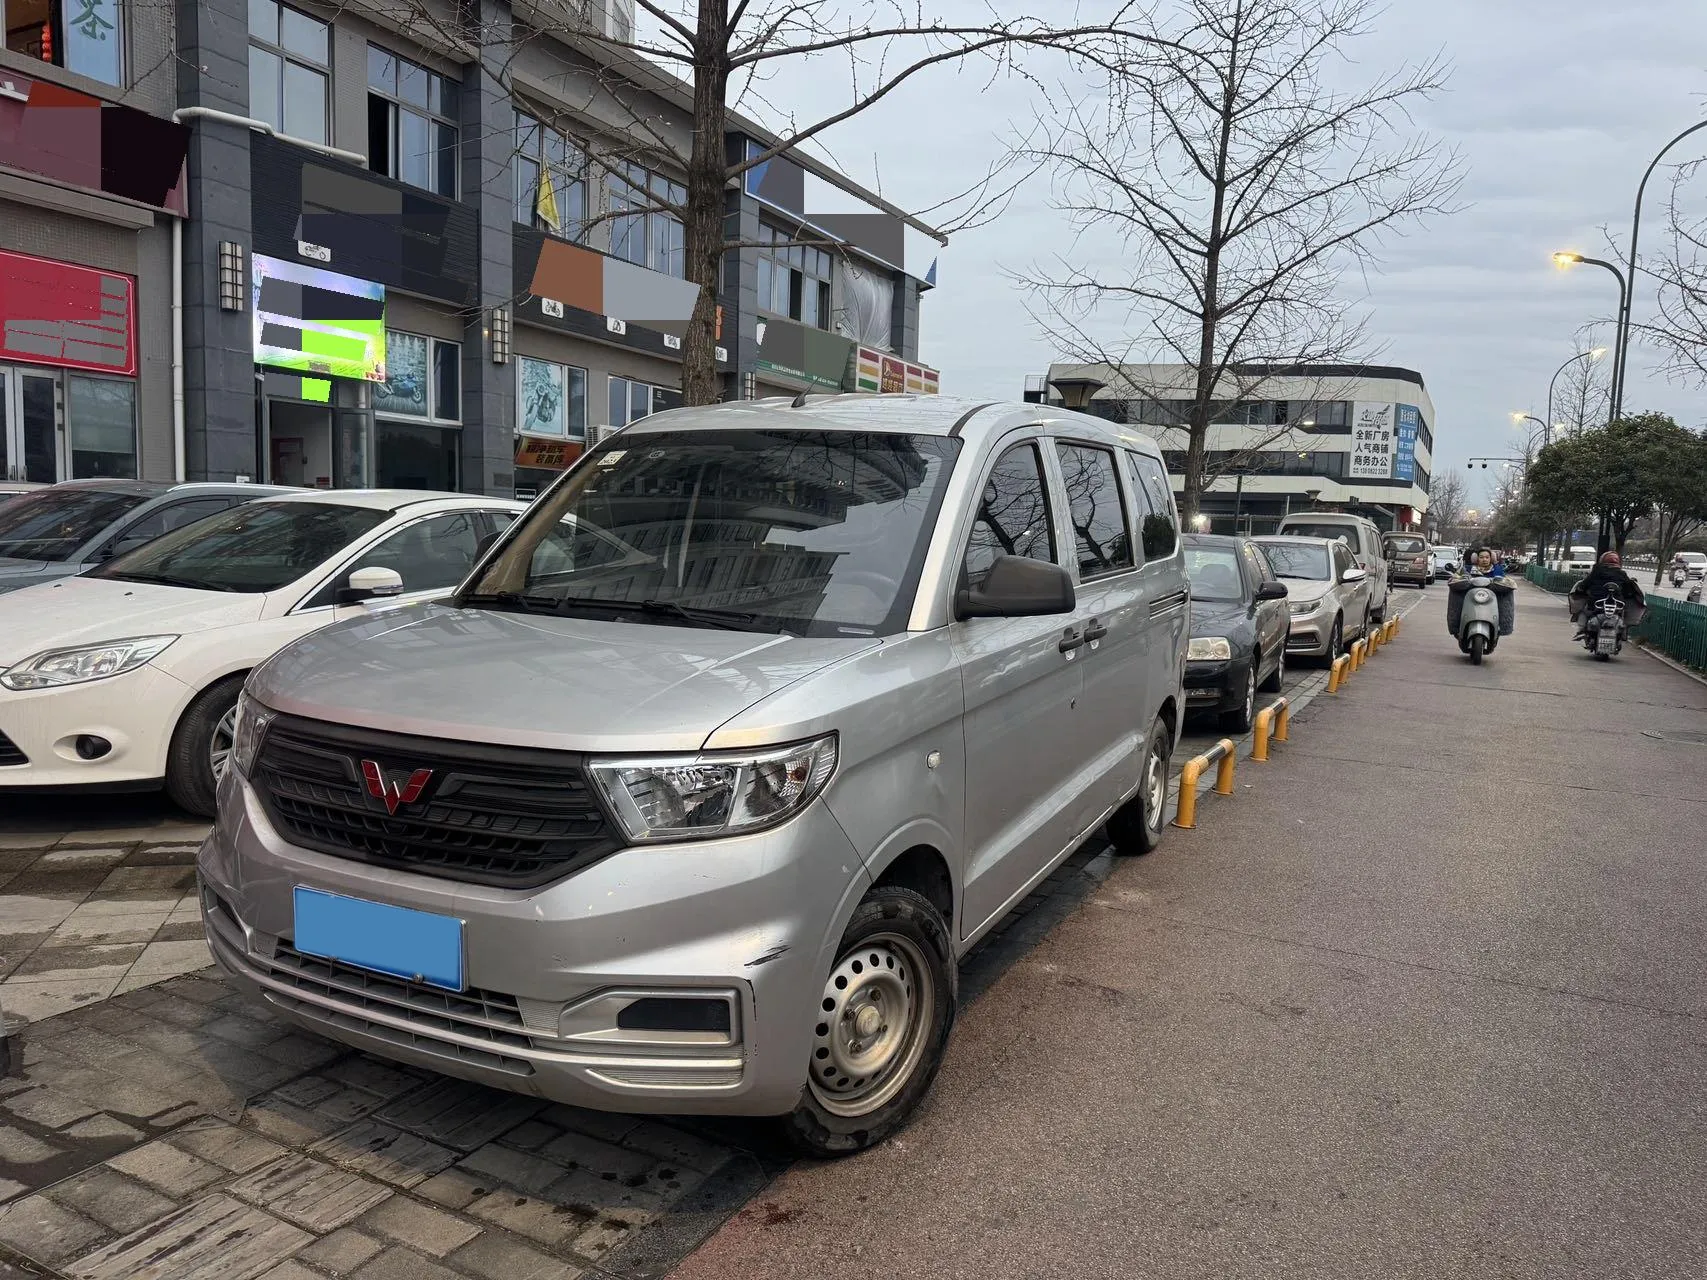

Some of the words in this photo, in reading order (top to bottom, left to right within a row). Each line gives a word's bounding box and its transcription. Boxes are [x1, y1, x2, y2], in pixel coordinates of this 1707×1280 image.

[1356, 430, 1389, 441] 全新厂房
[1355, 443, 1389, 454] 人气商铺
[1354, 455, 1388, 466] 商务办公
